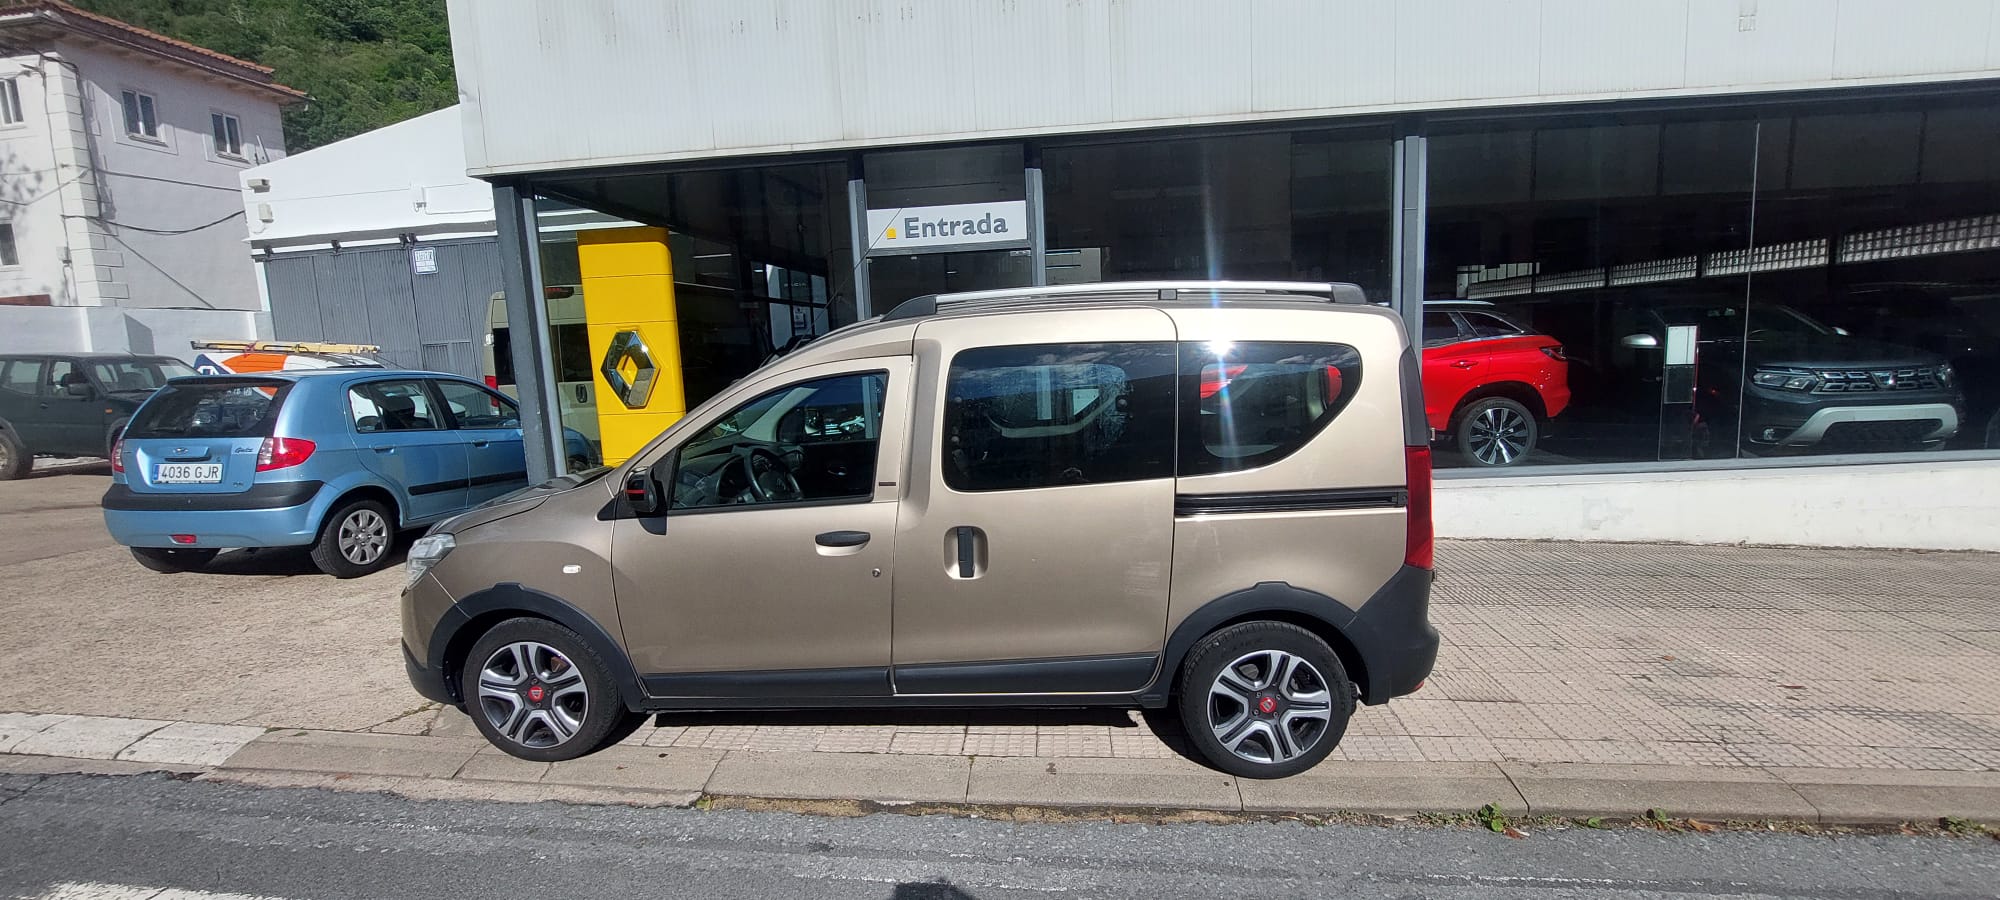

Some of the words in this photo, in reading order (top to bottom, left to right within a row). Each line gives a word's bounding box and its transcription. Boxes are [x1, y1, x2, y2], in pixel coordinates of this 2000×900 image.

[904, 212, 1008, 239] Entrada
[161, 466, 191, 479] 4036
[194, 466, 219, 479] GJR
